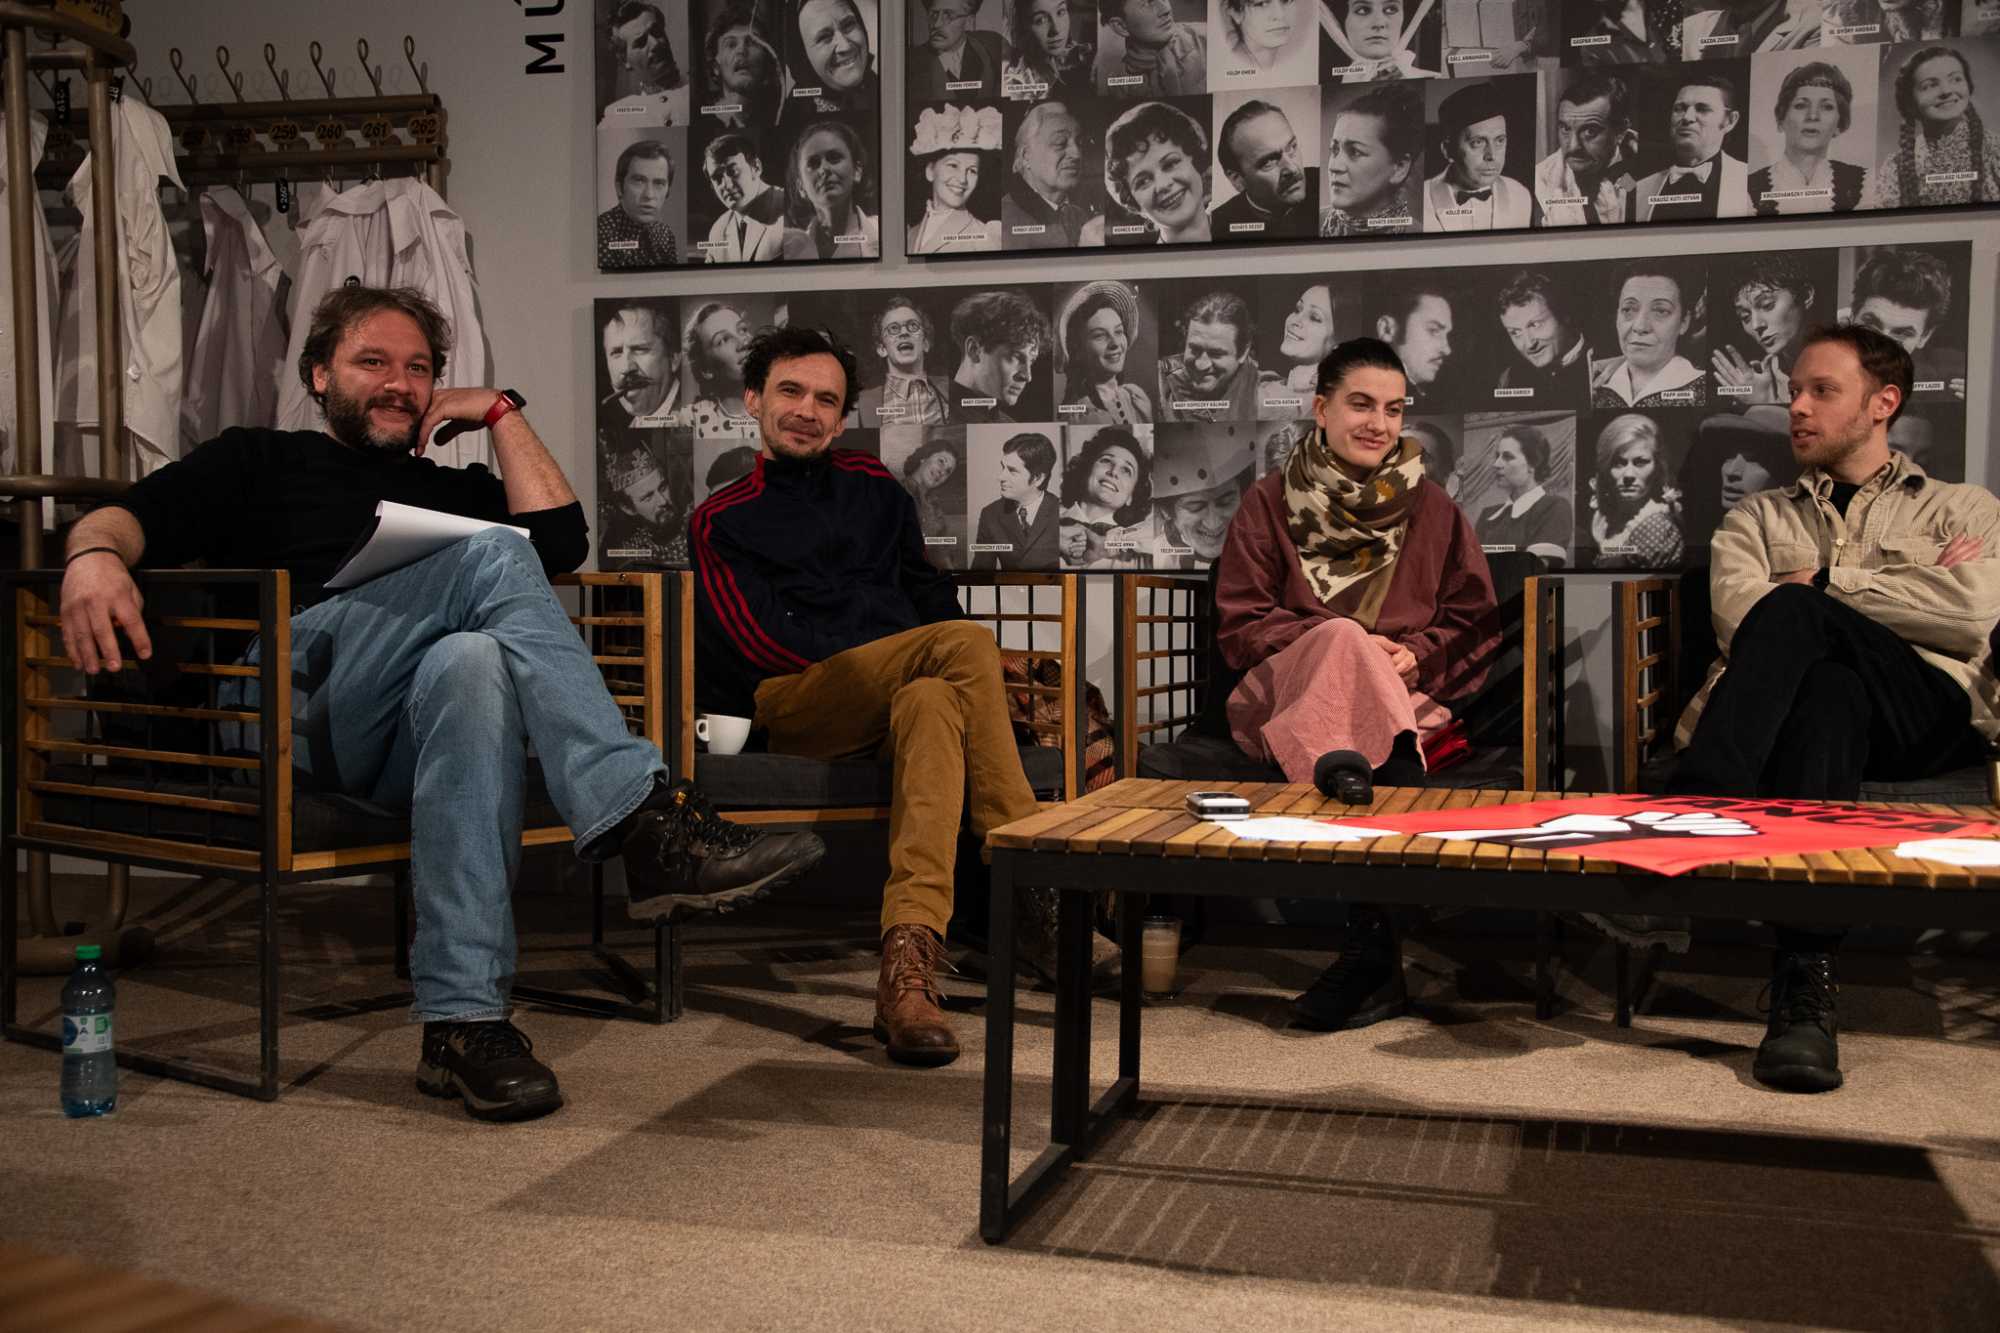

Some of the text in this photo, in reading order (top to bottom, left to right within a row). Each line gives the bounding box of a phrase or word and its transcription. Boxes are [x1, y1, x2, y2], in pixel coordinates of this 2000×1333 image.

[271, 124, 298, 139] 259
[317, 124, 343, 139] 260
[363, 121, 388, 138] 261
[410, 118, 437, 135] 262
